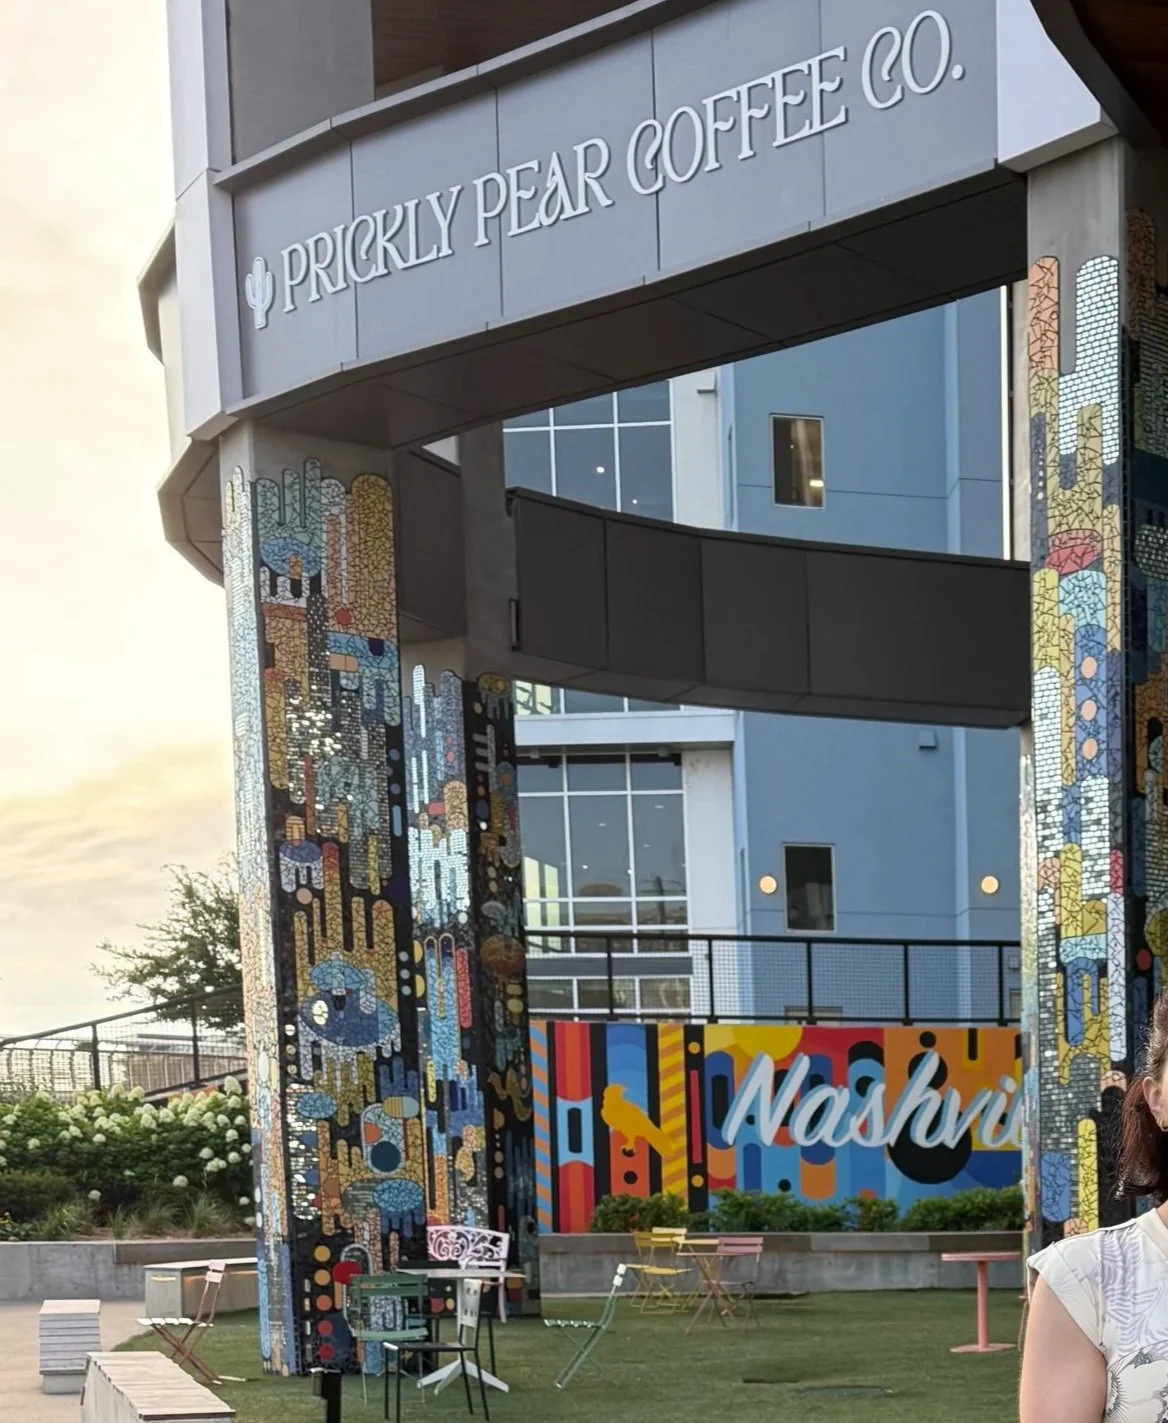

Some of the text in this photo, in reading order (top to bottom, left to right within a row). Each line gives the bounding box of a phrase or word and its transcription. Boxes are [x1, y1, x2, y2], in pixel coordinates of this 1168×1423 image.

[281, 10, 966, 313] PRICKLY PEAR COFFEE CO.
